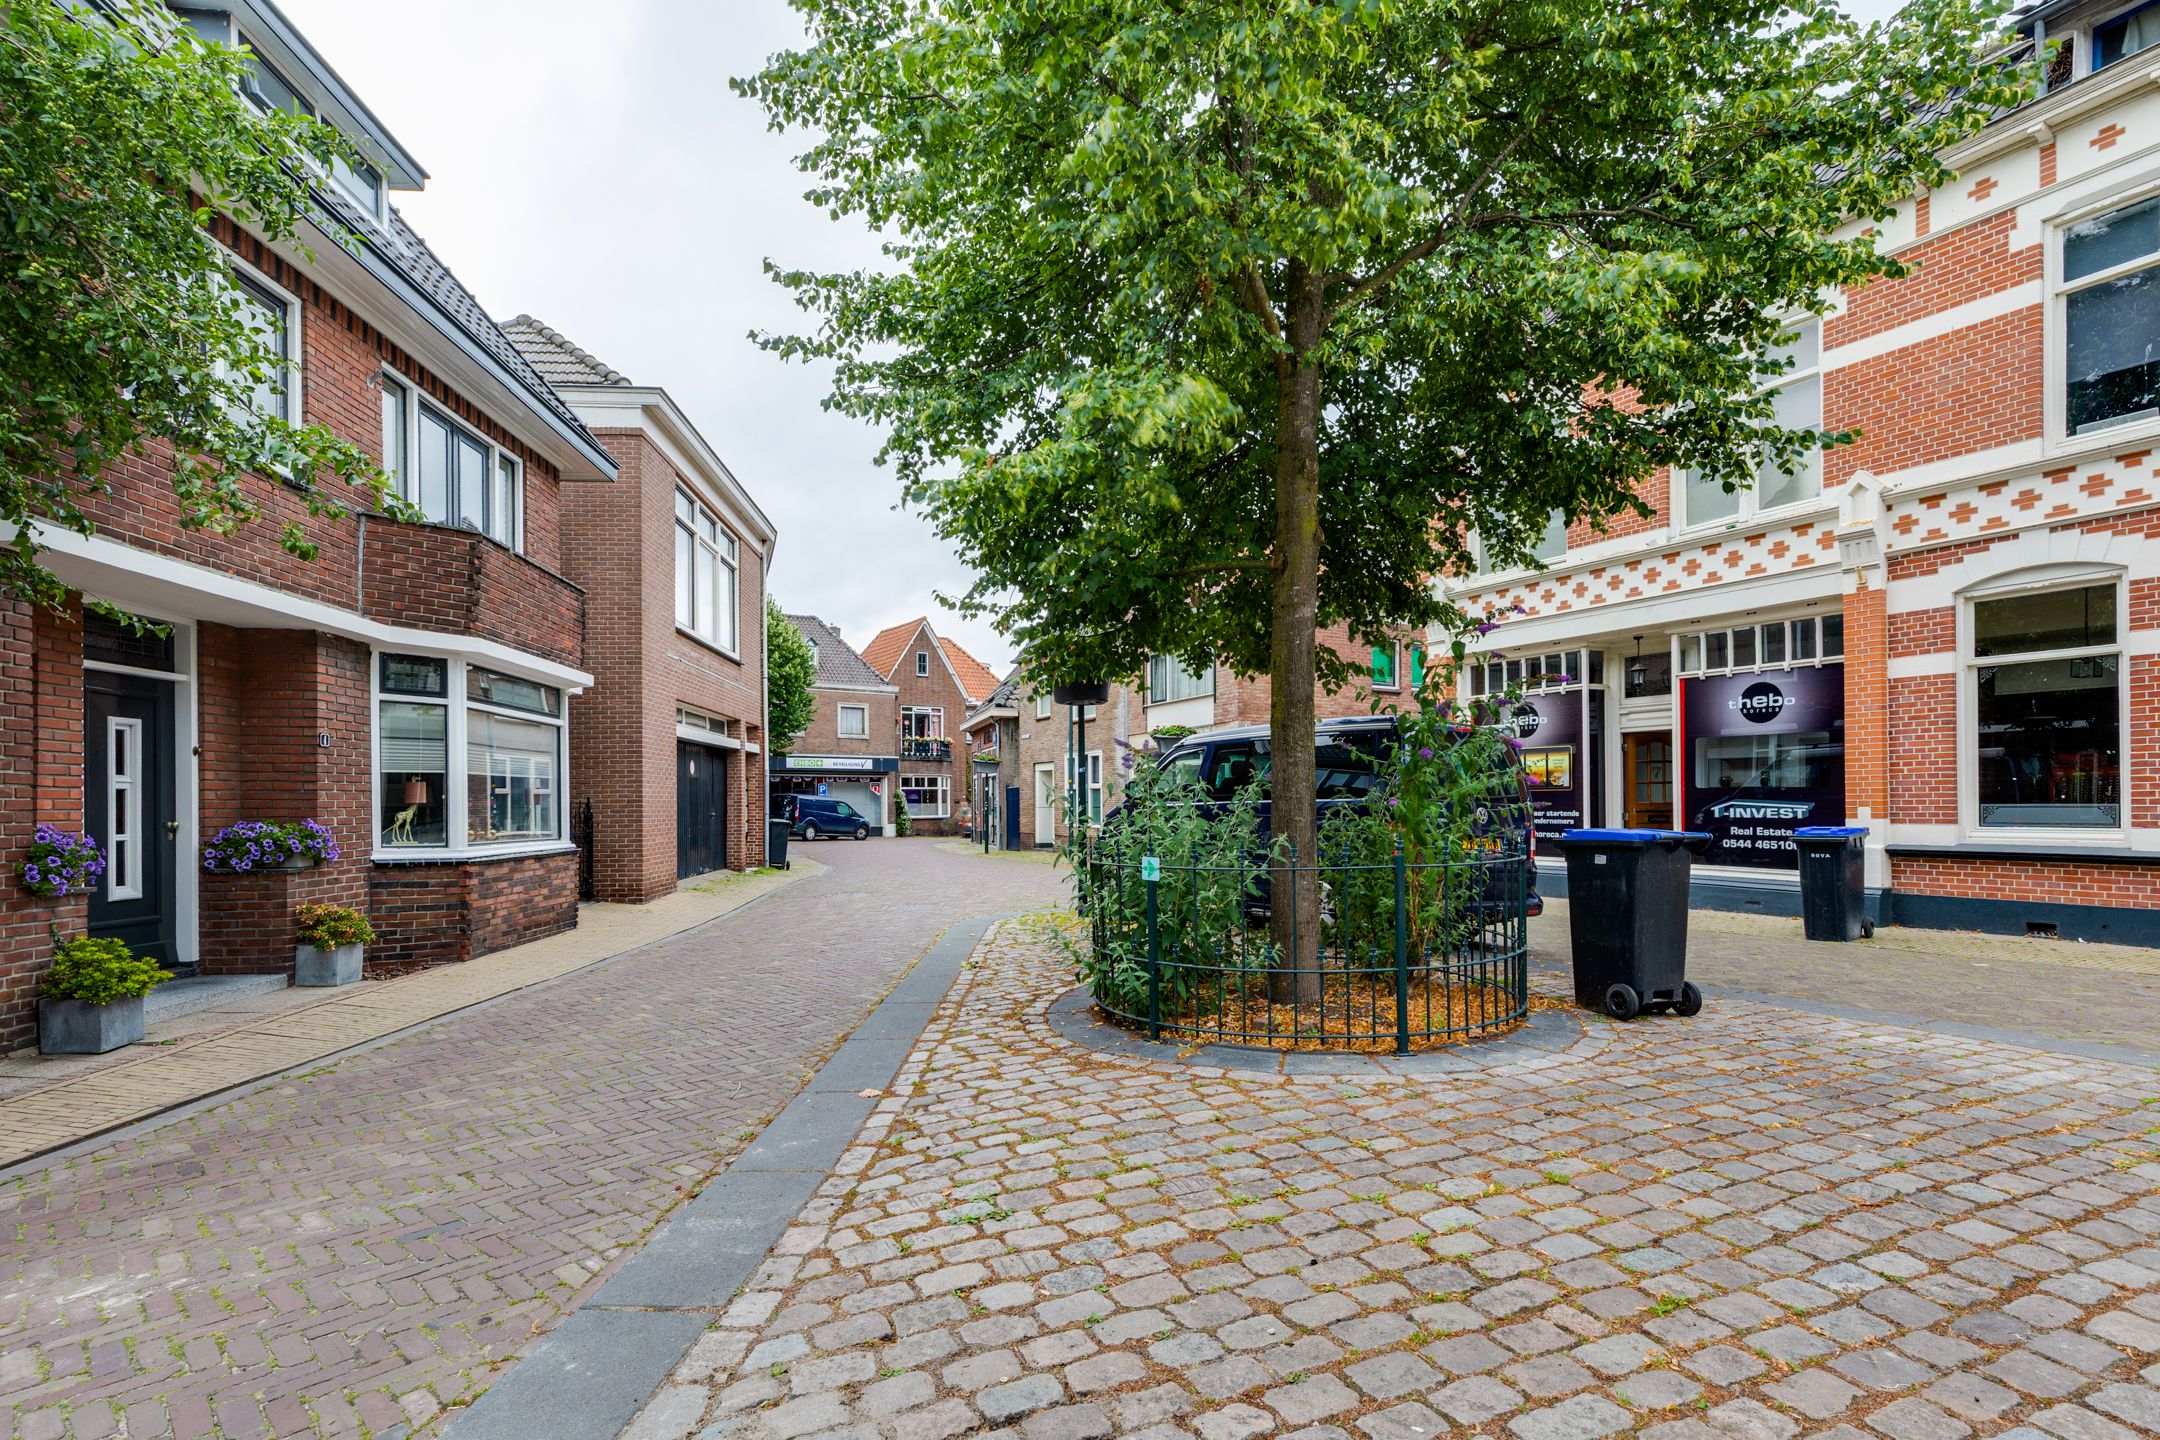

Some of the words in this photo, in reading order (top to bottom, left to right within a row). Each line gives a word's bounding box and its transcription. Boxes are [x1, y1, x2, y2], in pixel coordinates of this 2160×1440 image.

[1728, 693, 1796, 710] thebo
[1711, 805, 1807, 819] T-INVEST
[1730, 826, 1753, 836] Real
[1756, 826, 1793, 837] Estate
[1722, 839, 1752, 849] 0544
